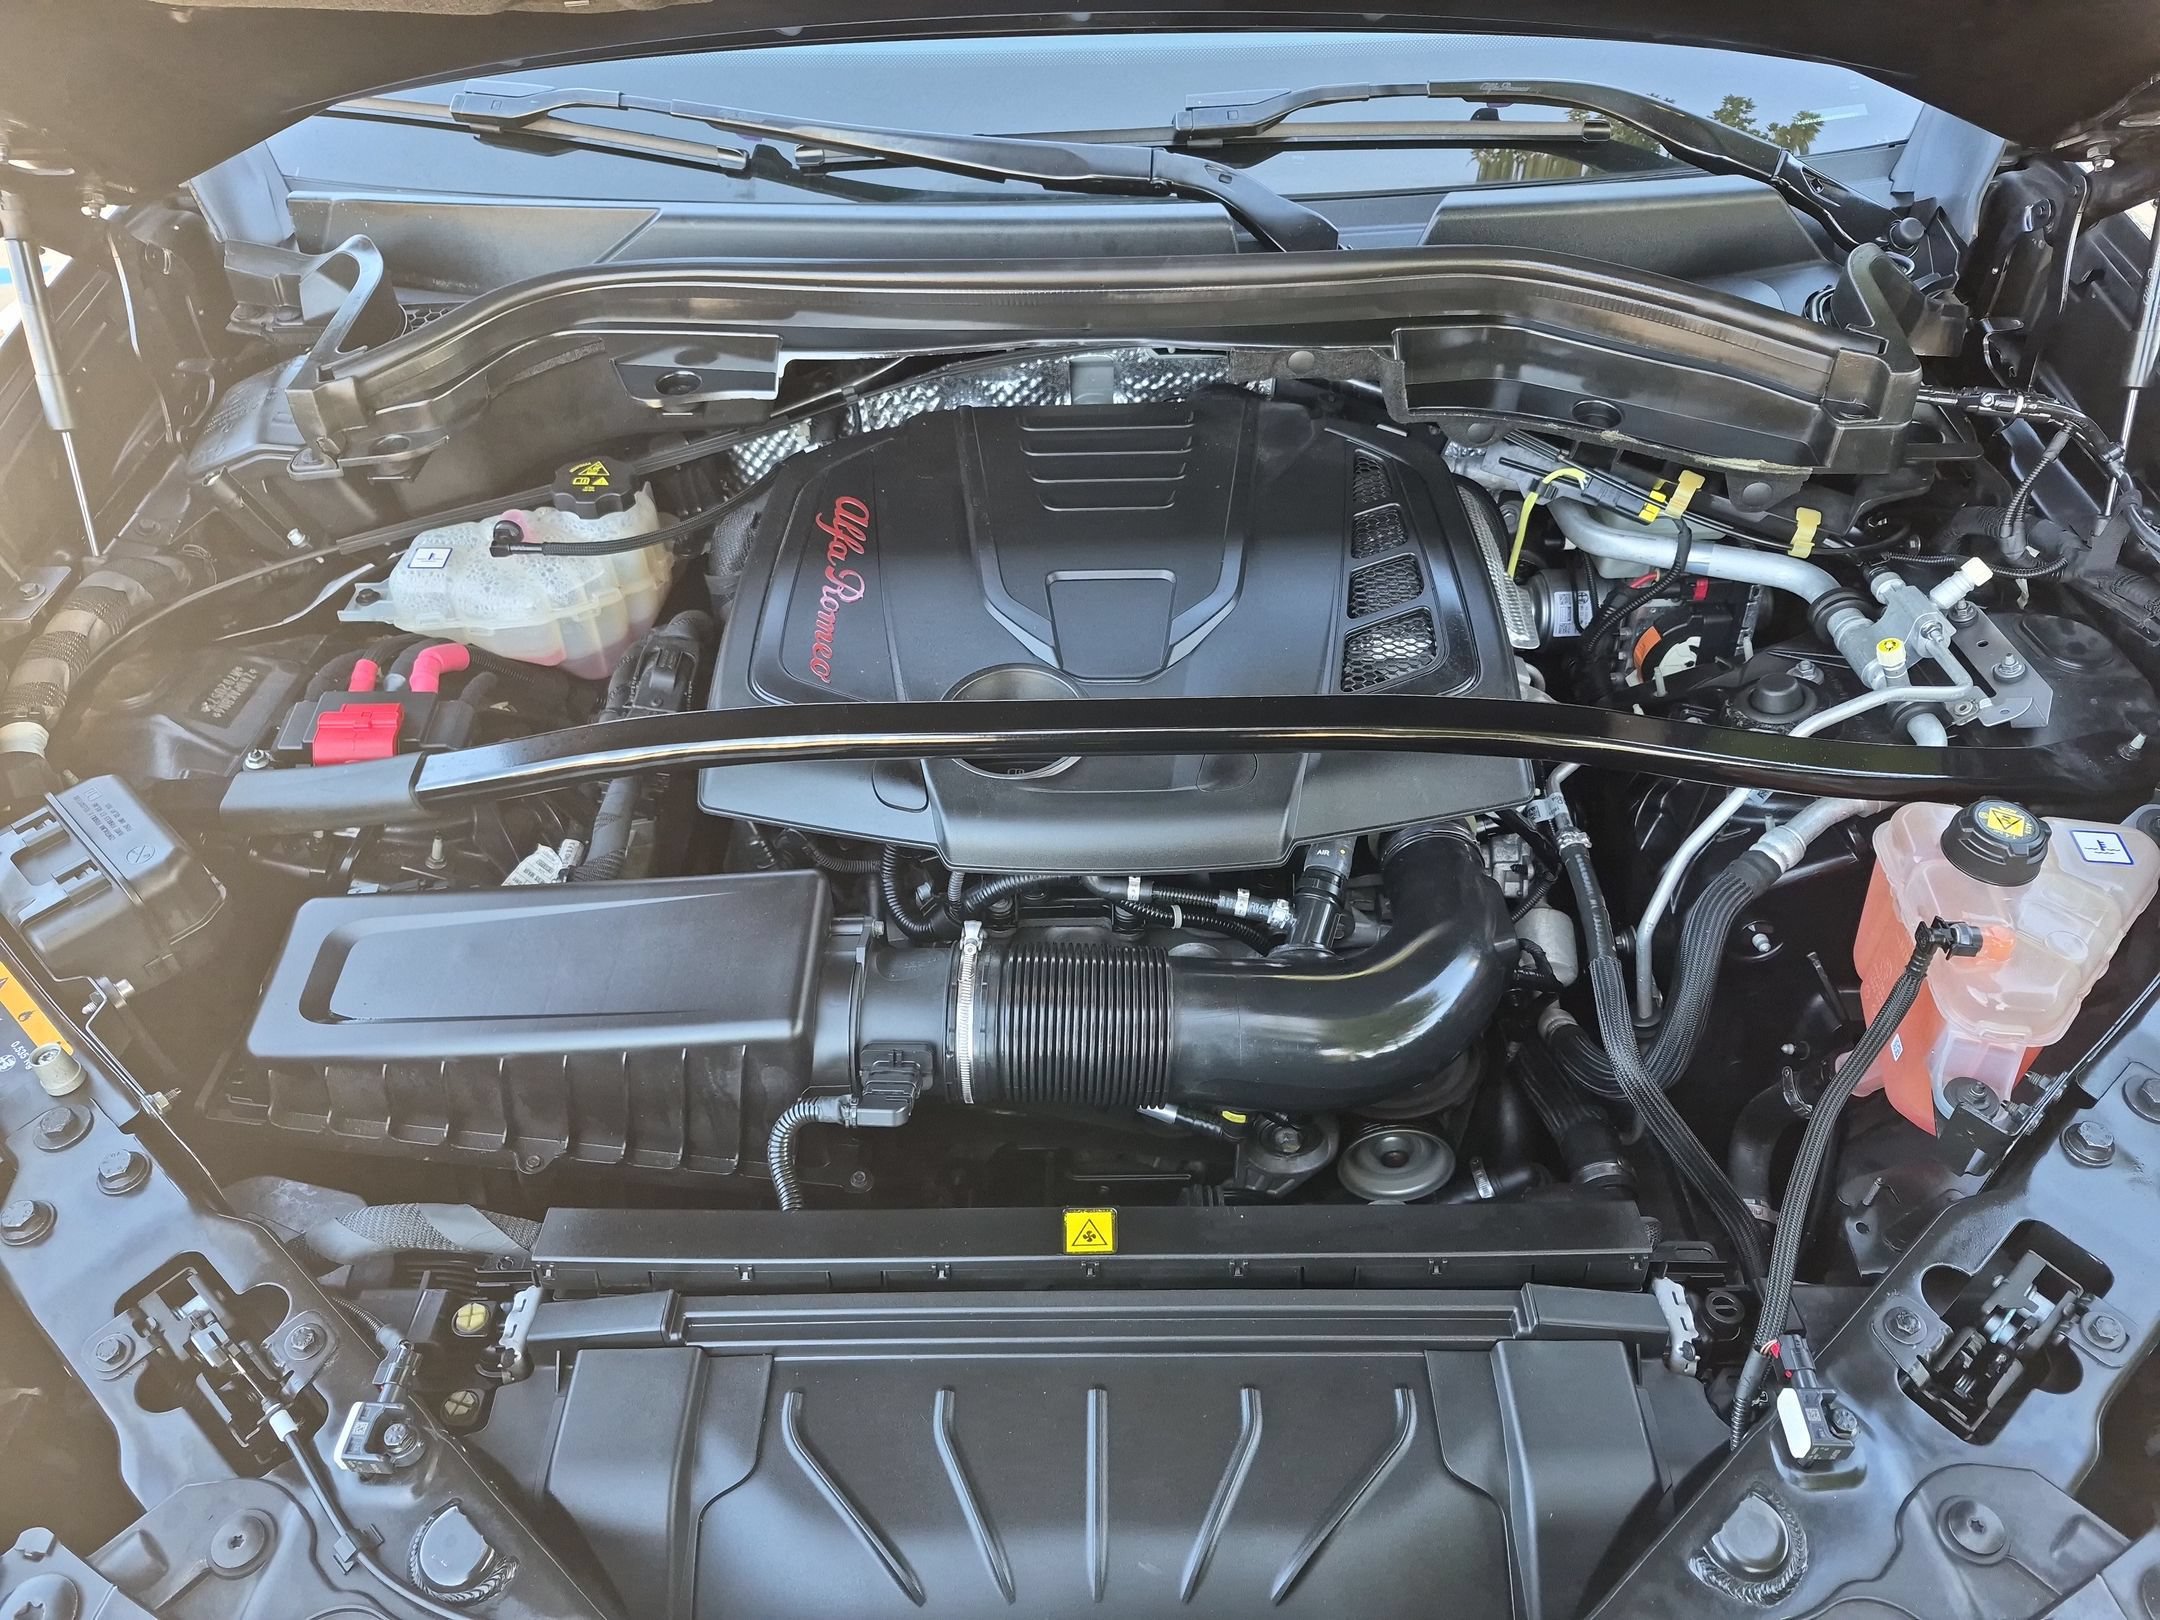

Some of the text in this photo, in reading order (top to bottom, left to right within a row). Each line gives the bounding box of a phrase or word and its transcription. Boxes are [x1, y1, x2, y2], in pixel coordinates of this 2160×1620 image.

[809, 496, 870, 684] Alfa Romeo
[10, 1040, 31, 1060] 0.535
